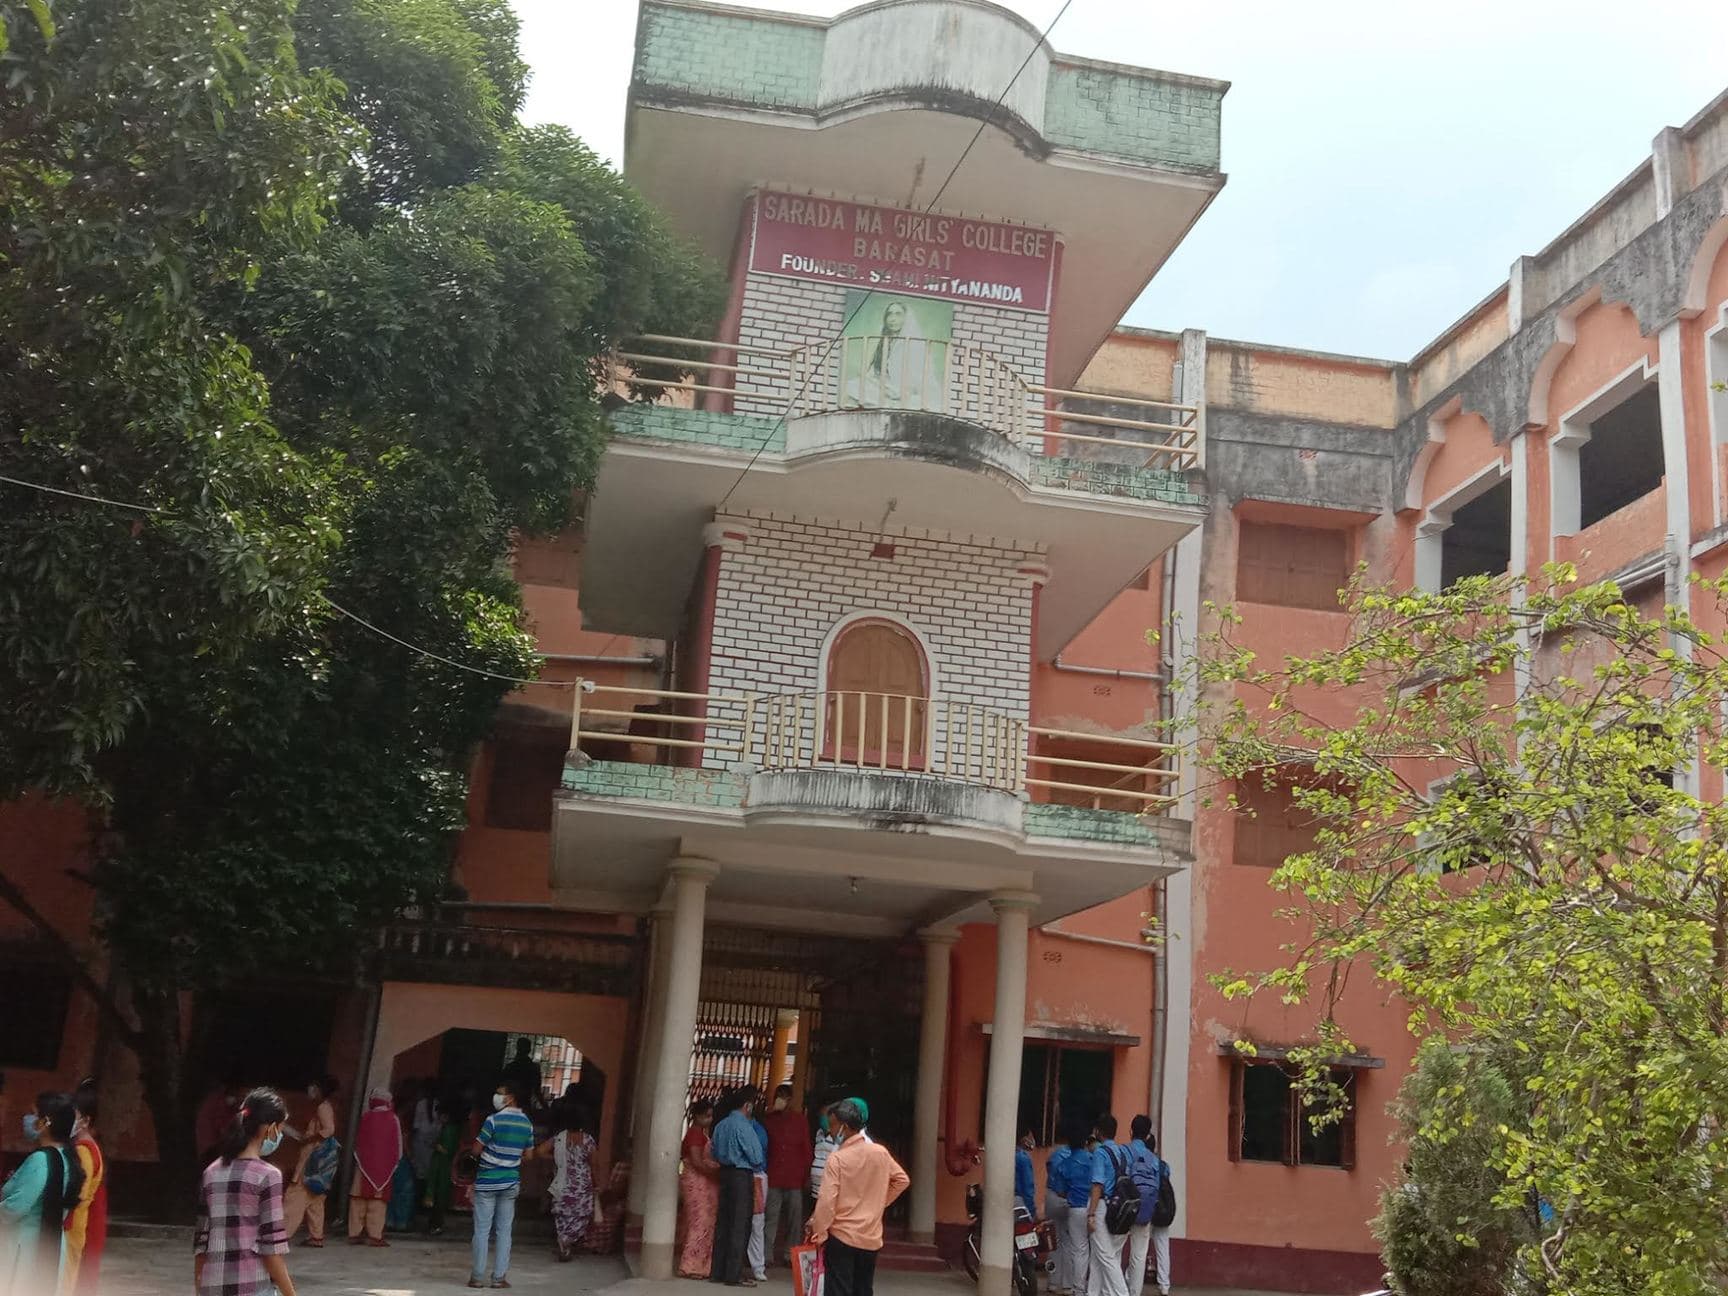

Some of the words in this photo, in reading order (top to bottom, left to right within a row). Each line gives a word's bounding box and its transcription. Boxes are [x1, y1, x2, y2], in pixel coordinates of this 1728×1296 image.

[764, 195, 845, 230] SARADA
[855, 207, 883, 234] MA
[962, 223, 1047, 259] COLLEGE
[854, 238, 956, 271] BARASAT
